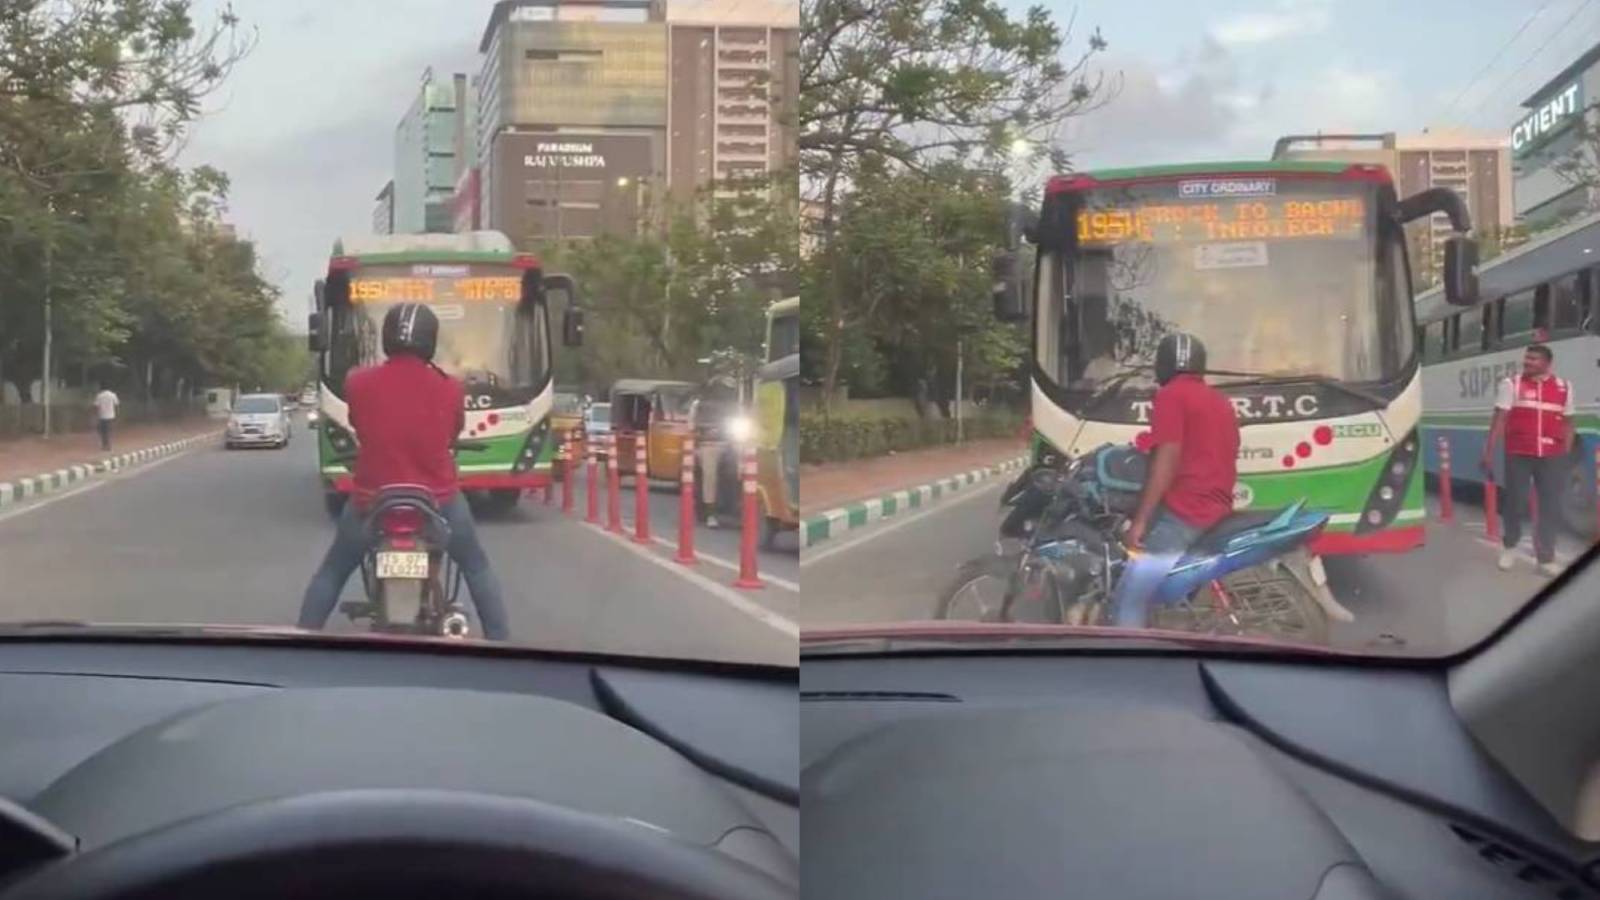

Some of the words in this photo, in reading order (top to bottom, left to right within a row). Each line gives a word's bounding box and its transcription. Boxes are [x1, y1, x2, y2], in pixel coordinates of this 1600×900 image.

[1512, 84, 1578, 149] CYIENT
[1182, 183, 1208, 194] CITY
[1210, 181, 1271, 193] ORDINARY
